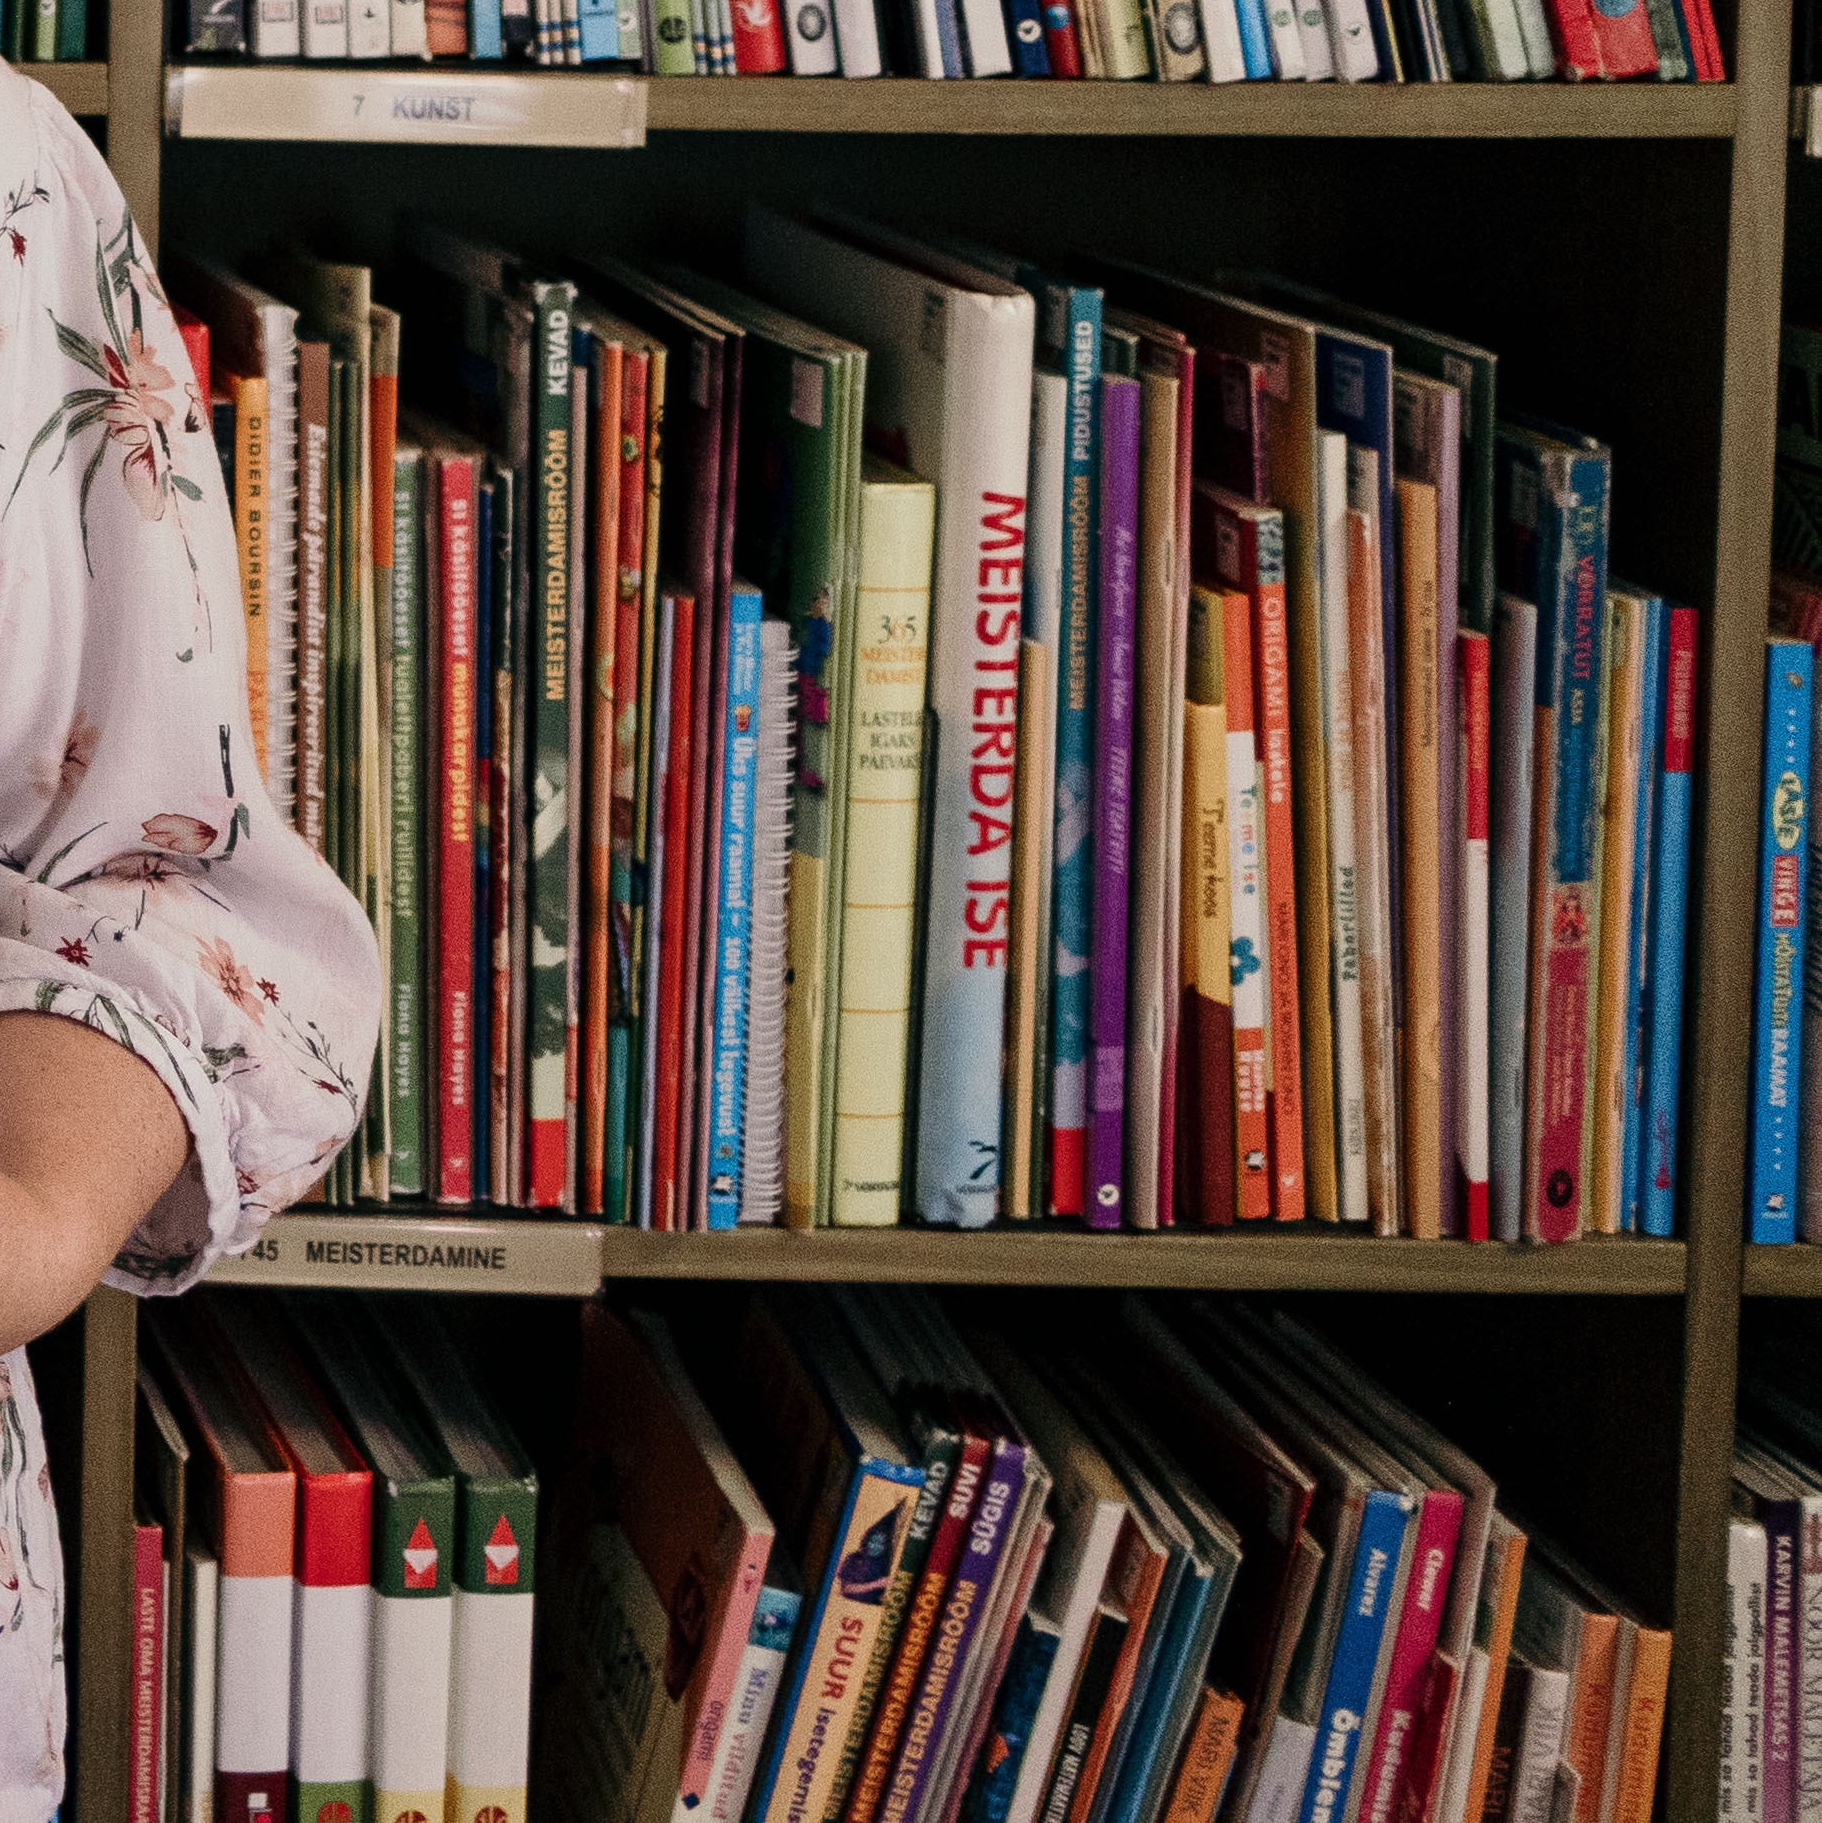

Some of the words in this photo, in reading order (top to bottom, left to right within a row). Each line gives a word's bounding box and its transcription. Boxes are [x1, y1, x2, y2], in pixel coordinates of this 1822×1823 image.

[350, 95, 366, 118] 7
[391, 95, 476, 123] KUNST
[546, 308, 570, 398] KEVAD
[1071, 319, 1095, 462] PIDUSTUSED
[247, 415, 262, 500] DIDIER
[247, 509, 262, 618] BOURSIN
[544, 429, 568, 701] MEISTERDAMISRÕÕM
[968, 490, 1027, 856] MEISTERDA
[1263, 596, 1288, 718] ORIGAMI
[1268, 727, 1290, 805] lastele
[1201, 798, 1227, 870] Teeme
[963, 880, 1011, 971] ISE
[1203, 875, 1224, 920] koos
[1772, 856, 1798, 927] VINGE
[305, 1240, 508, 1272] MEISTERDAMINE
[907, 1459, 950, 1541] KEVAD
[947, 1461, 981, 1520] SUVI
[969, 1481, 1011, 1557] SÜGIS
[140, 1587, 155, 1632] LASTE
[1358, 1547, 1388, 1616] Alvarez
[1775, 1535, 1792, 1611] KARVIN
[140, 1637, 154, 1676] OMA
[821, 1615, 865, 1700] SUUR
[1771, 1616, 1792, 1744] MALEMETSAS
[697, 1699, 724, 1763] origami
